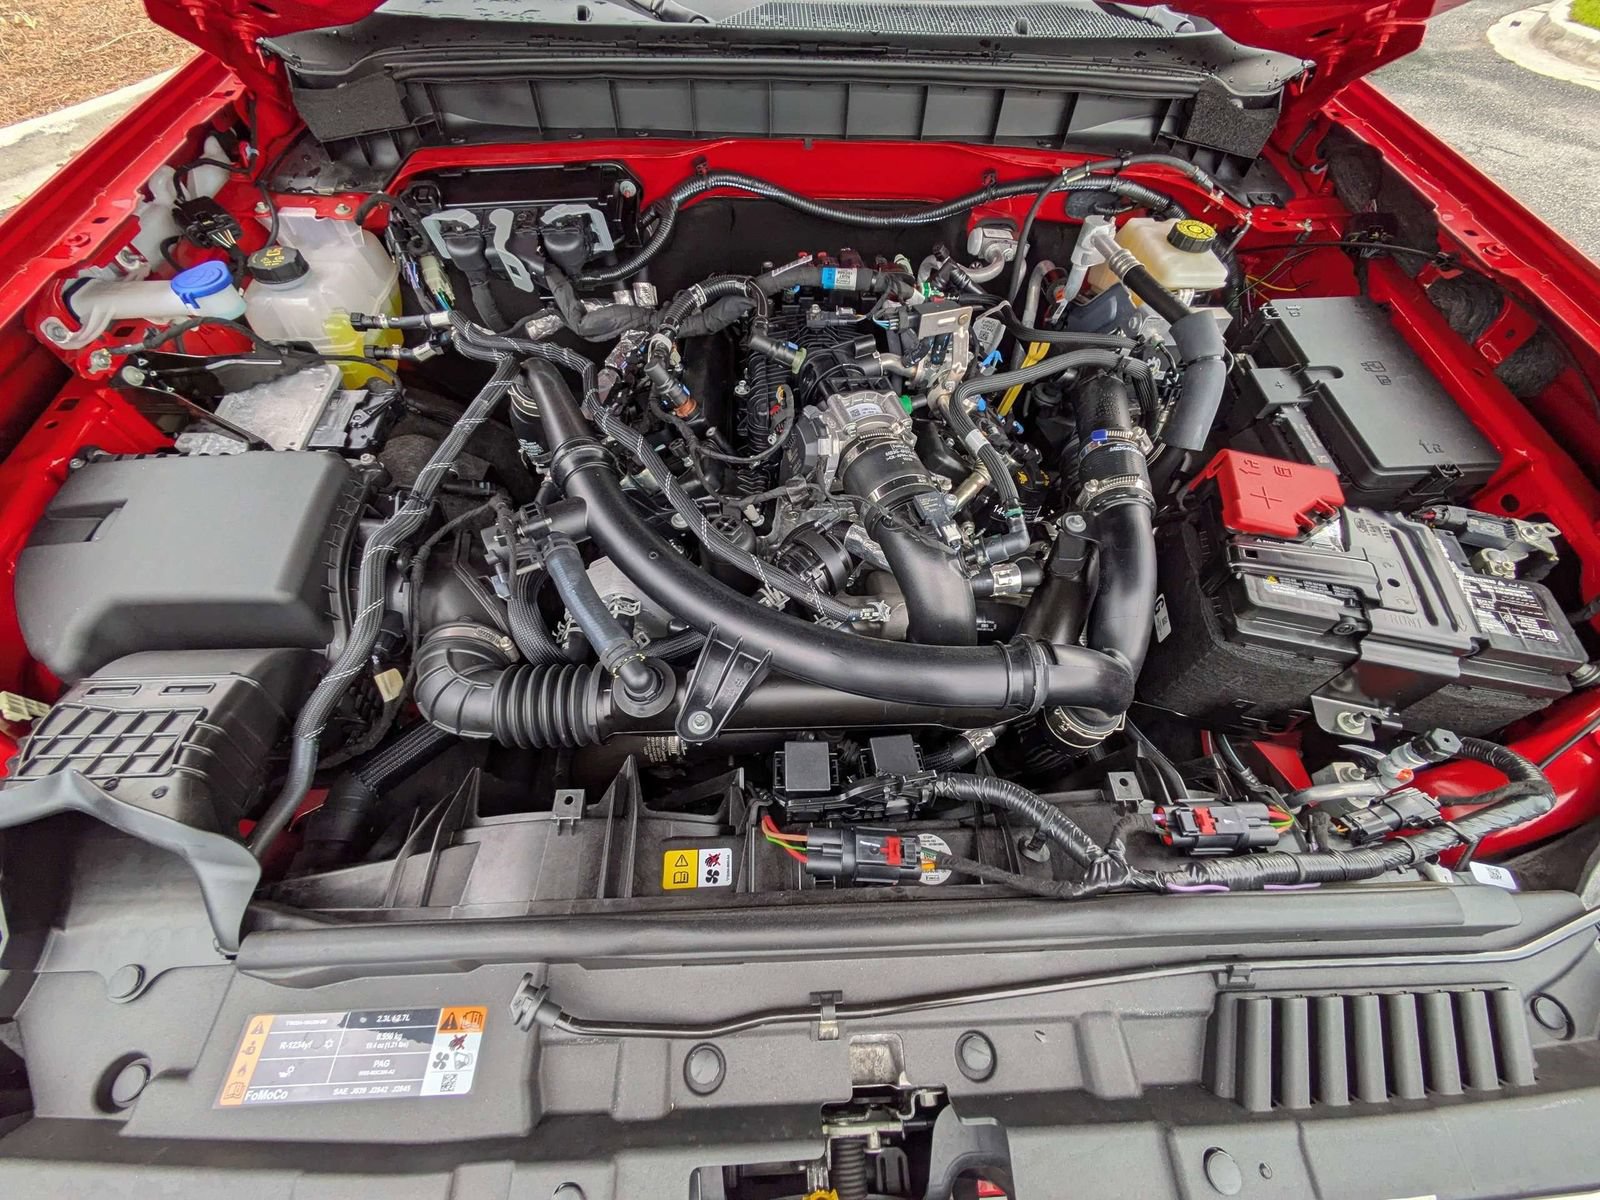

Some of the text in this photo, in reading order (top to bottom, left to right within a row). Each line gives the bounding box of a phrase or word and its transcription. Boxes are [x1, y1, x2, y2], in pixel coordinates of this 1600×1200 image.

[394, 1032, 403, 1042] kg
[280, 1039, 314, 1050] R-1234yf
[373, 1059, 390, 1068] PAG
[244, 1089, 288, 1101] FoMoCo
[332, 1088, 349, 1096] SAE
